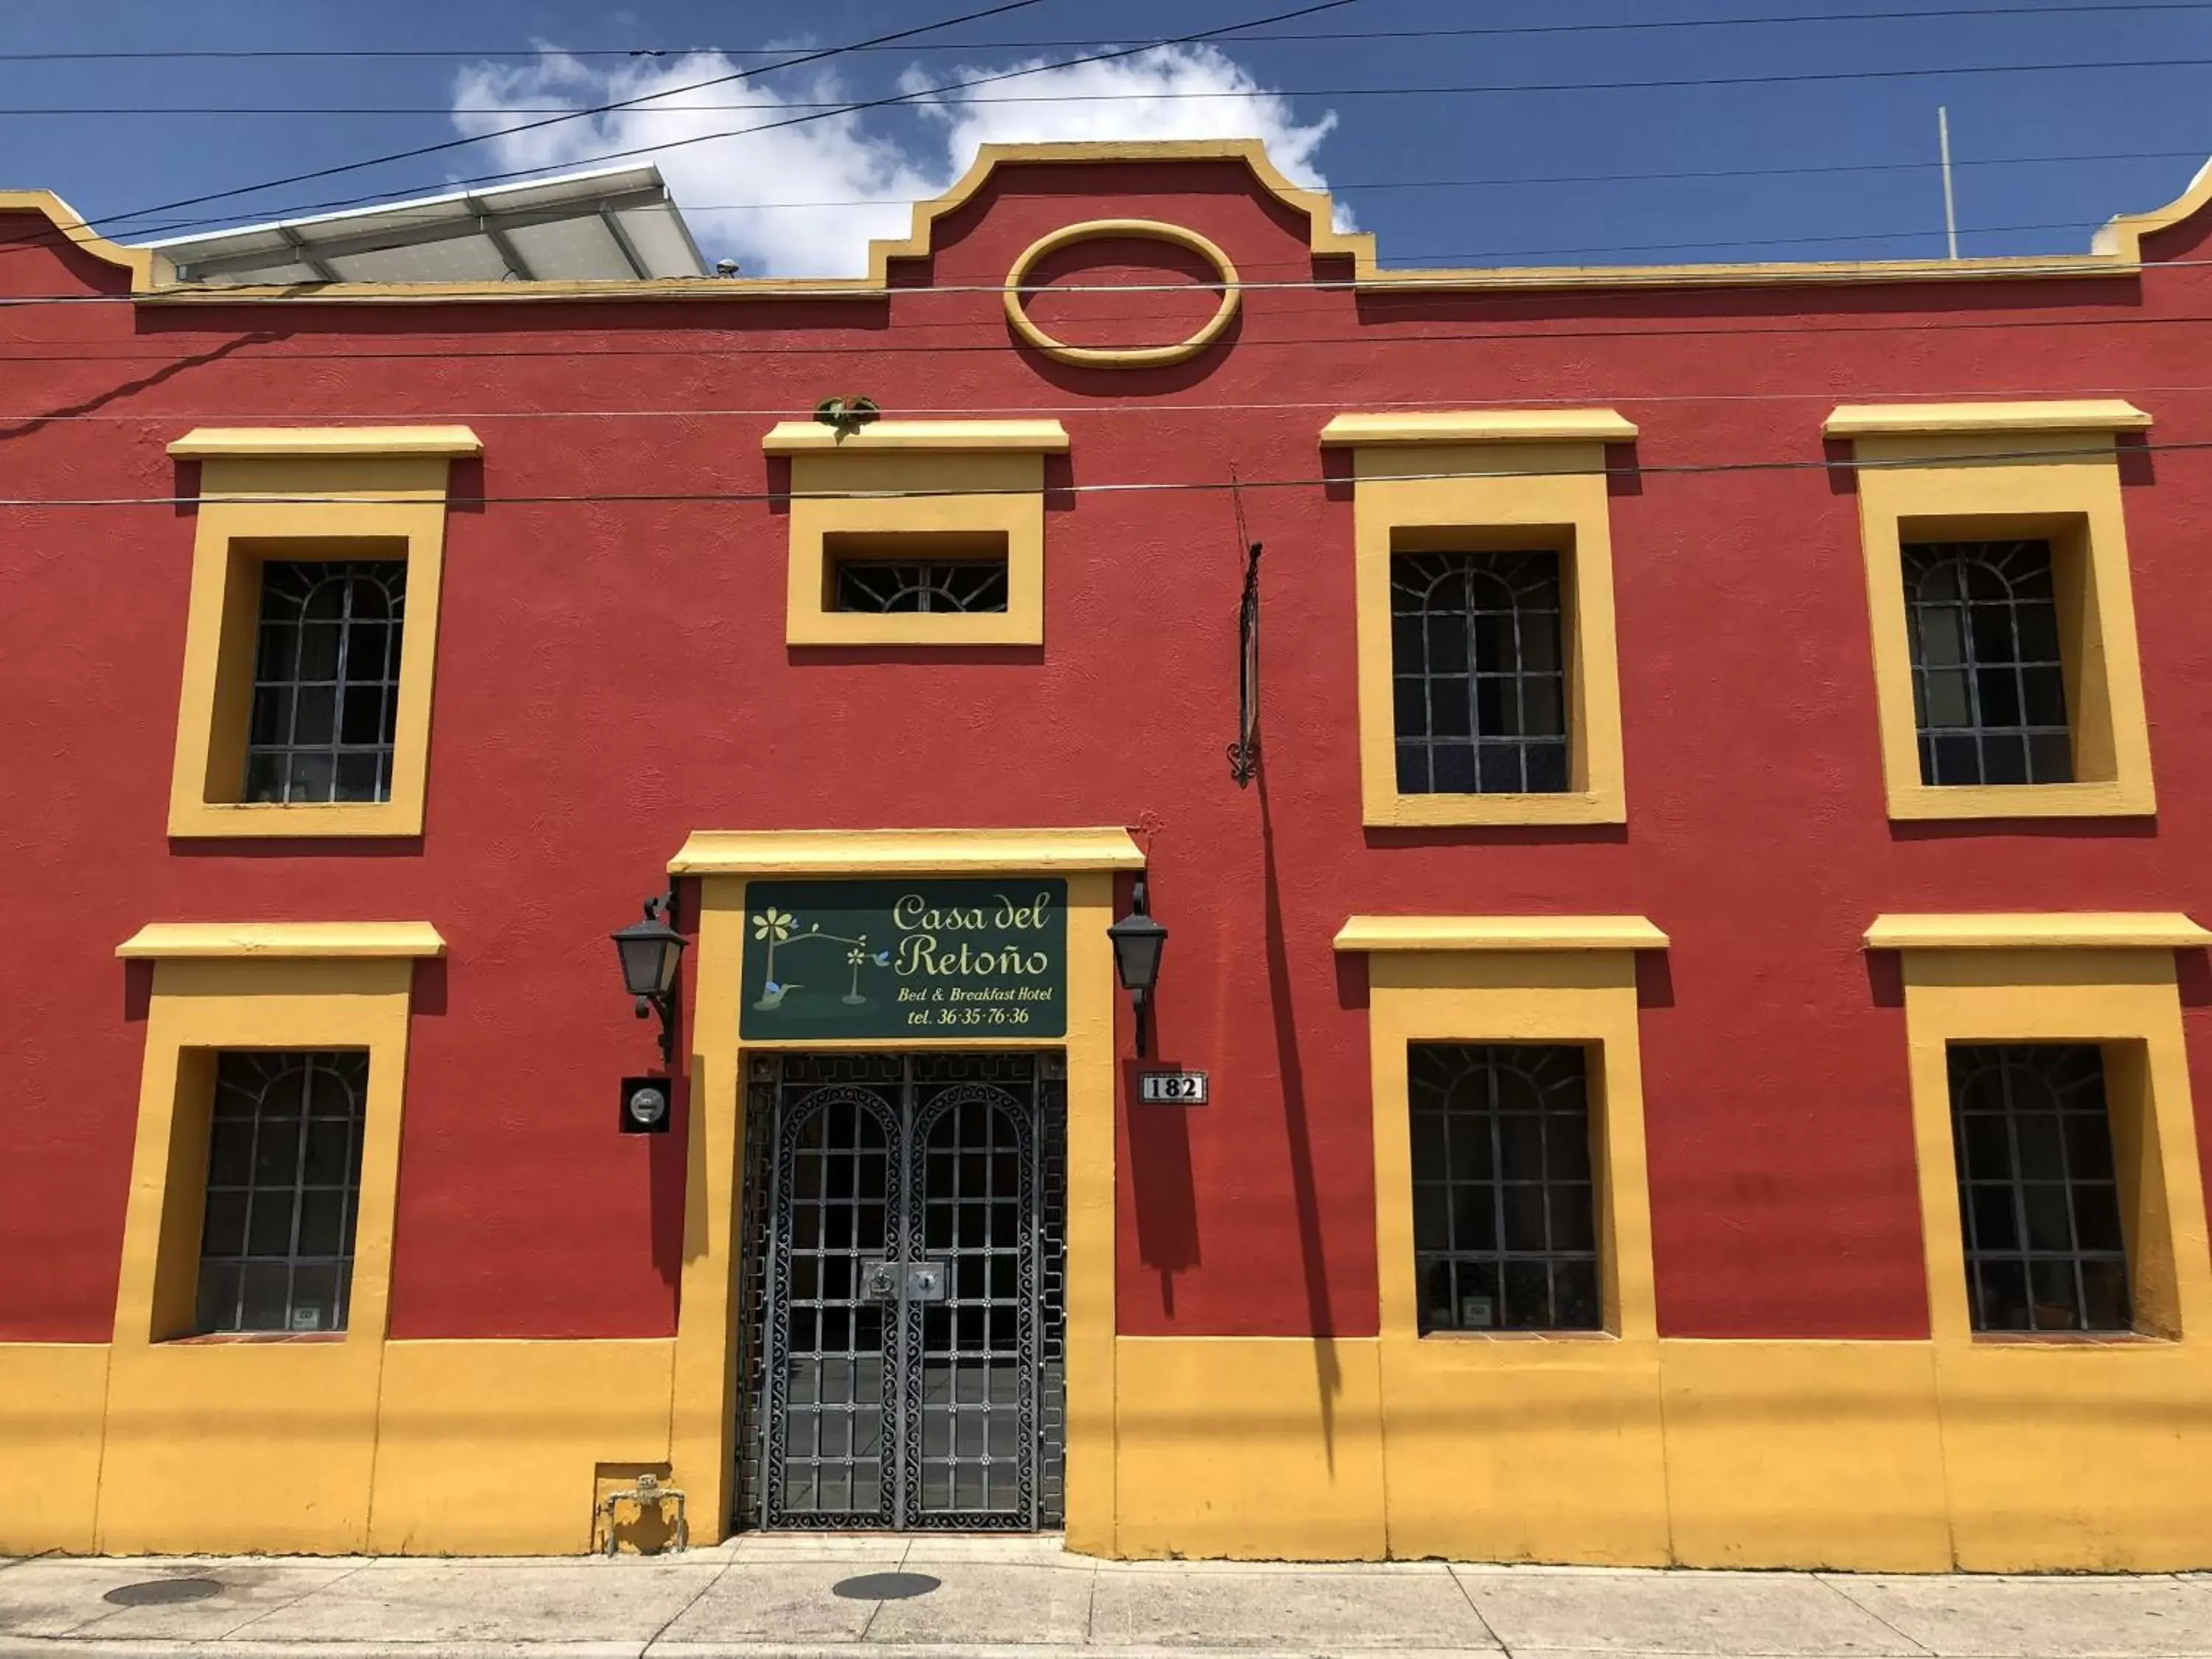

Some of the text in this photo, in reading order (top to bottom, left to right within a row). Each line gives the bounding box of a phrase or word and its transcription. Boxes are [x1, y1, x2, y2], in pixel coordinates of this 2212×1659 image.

[893, 891, 1051, 931] Casa del
[894, 934, 1048, 975] Retoño
[897, 987, 1053, 1001] Bed & Breakfast Hotel
[908, 1009, 933, 1024] tel.
[1152, 1079, 1196, 1097] 182
